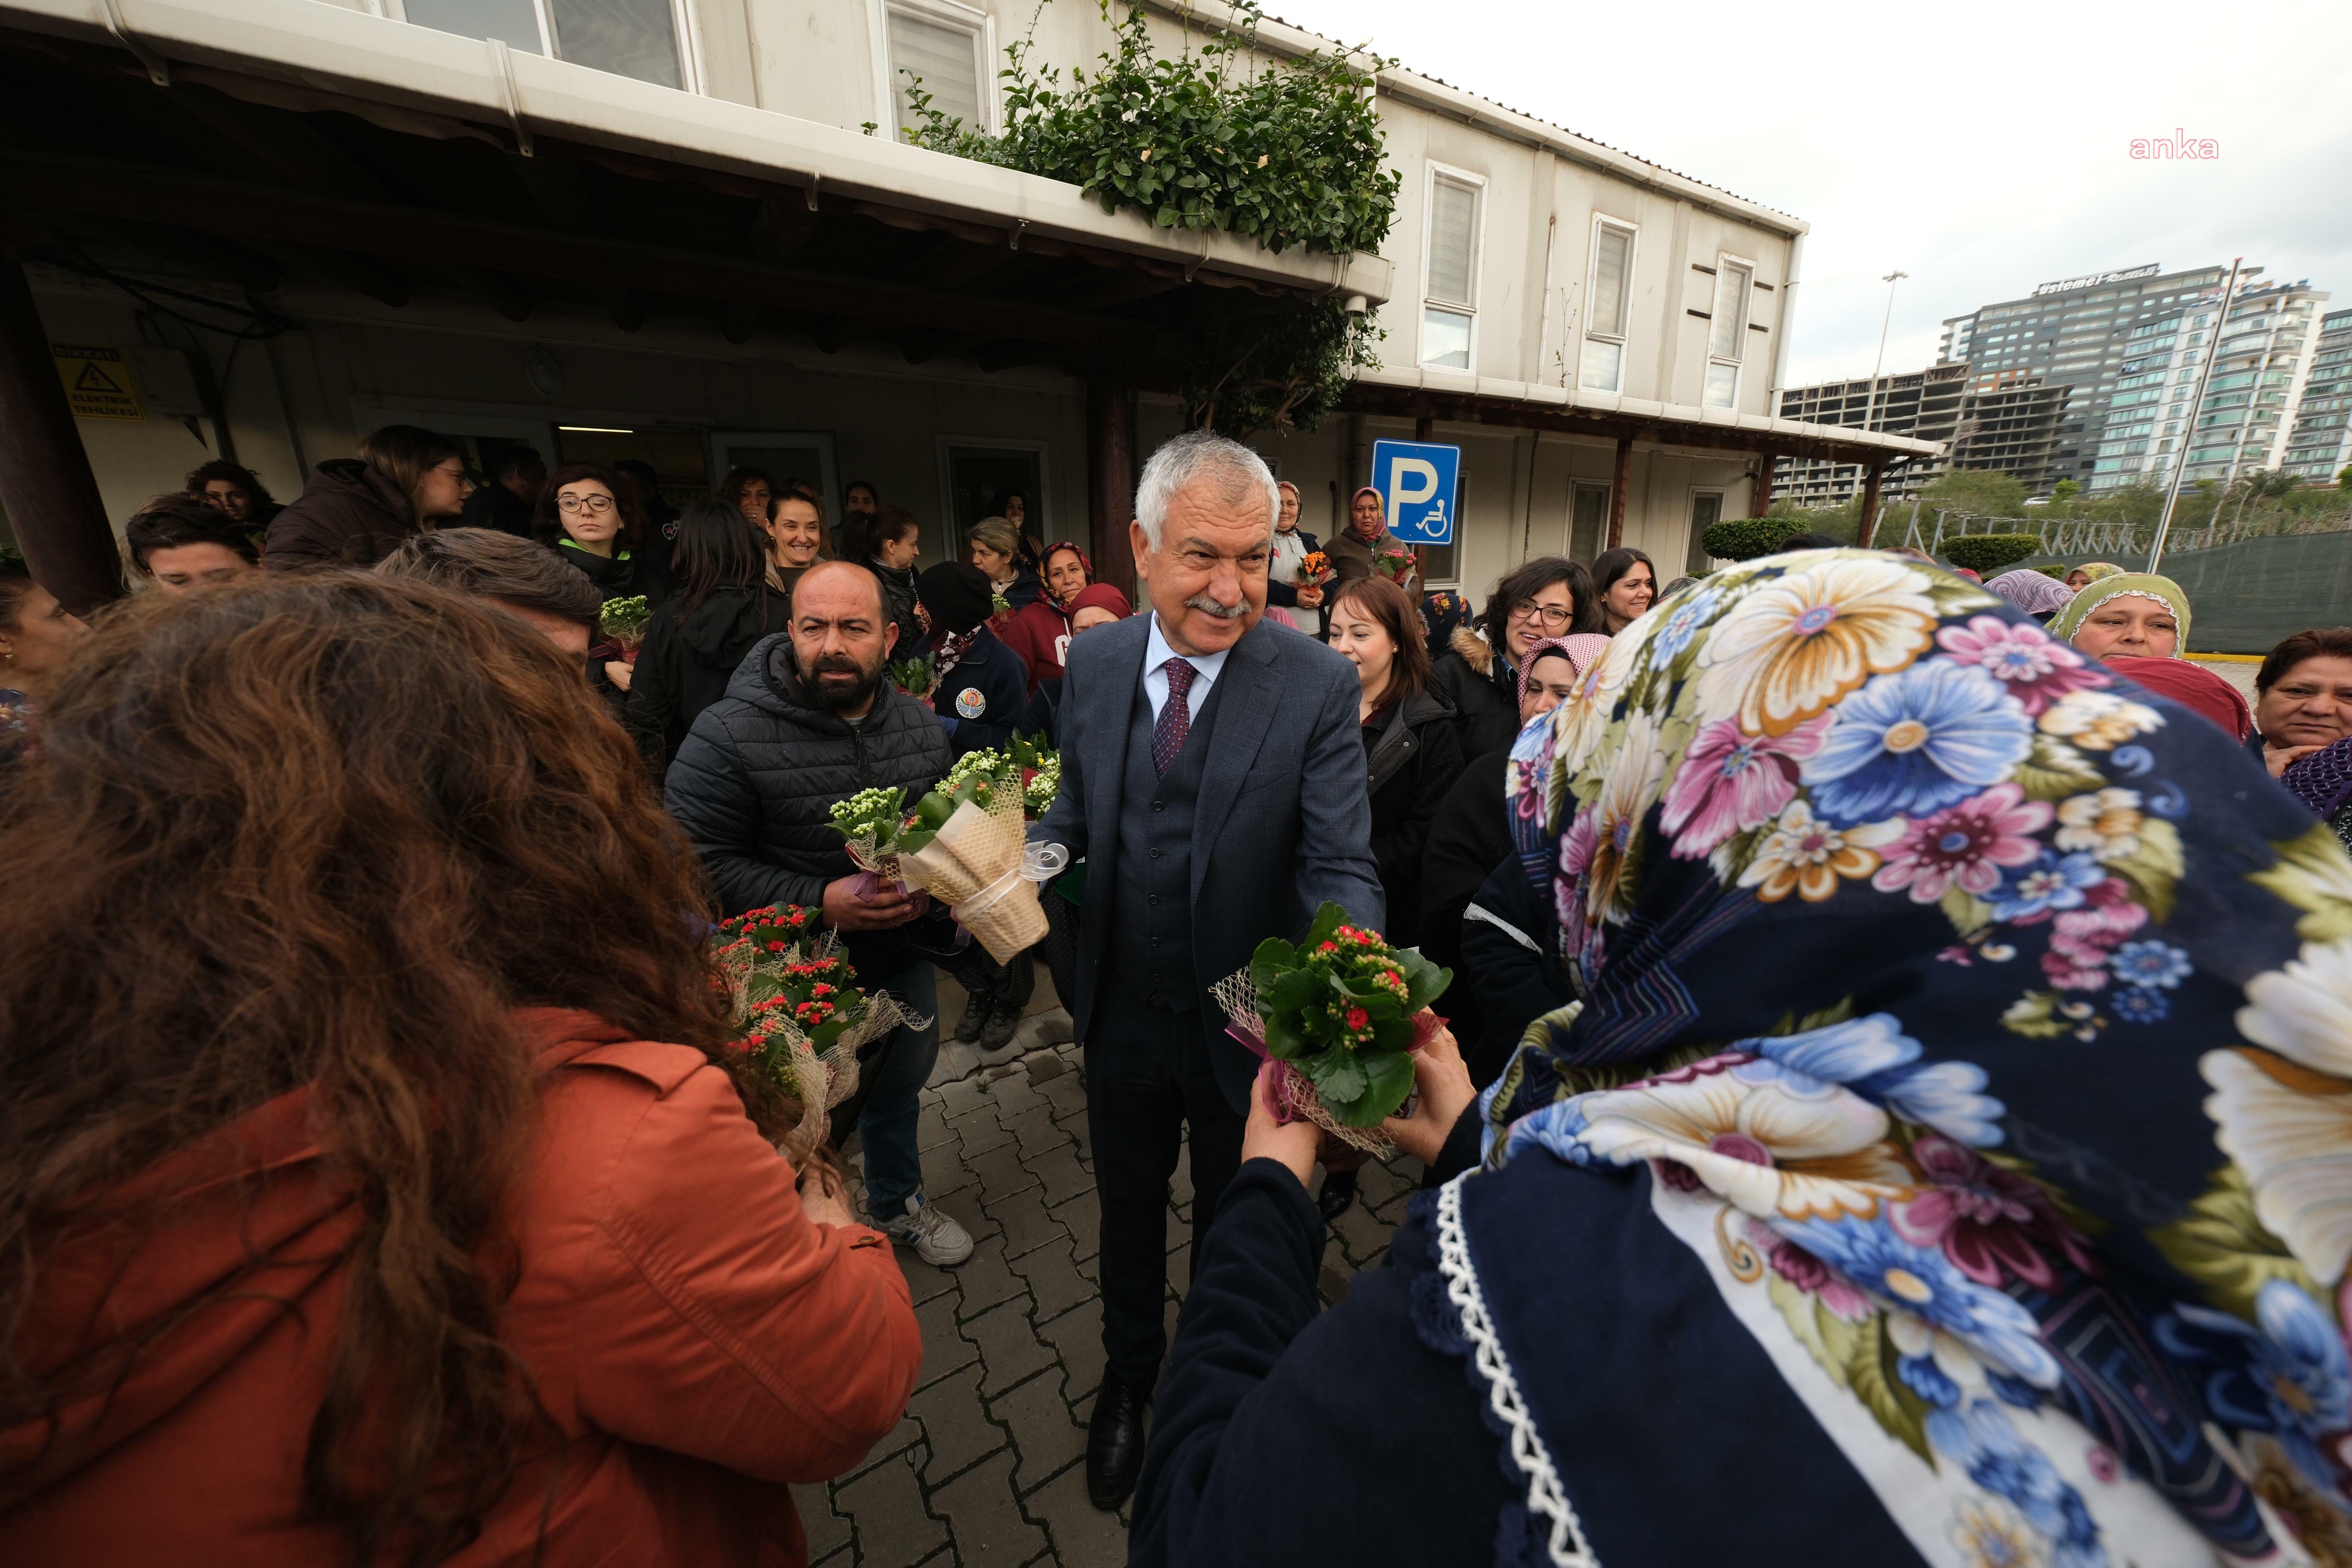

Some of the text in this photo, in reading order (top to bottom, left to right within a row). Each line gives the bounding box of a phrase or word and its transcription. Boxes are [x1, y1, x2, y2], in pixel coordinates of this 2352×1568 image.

[2038, 273, 2104, 295] üstemel
[72, 394, 133, 405] ELEKTRİK
[74, 405, 139, 416] TEHLİKESİ
[1387, 457, 1438, 527] P
